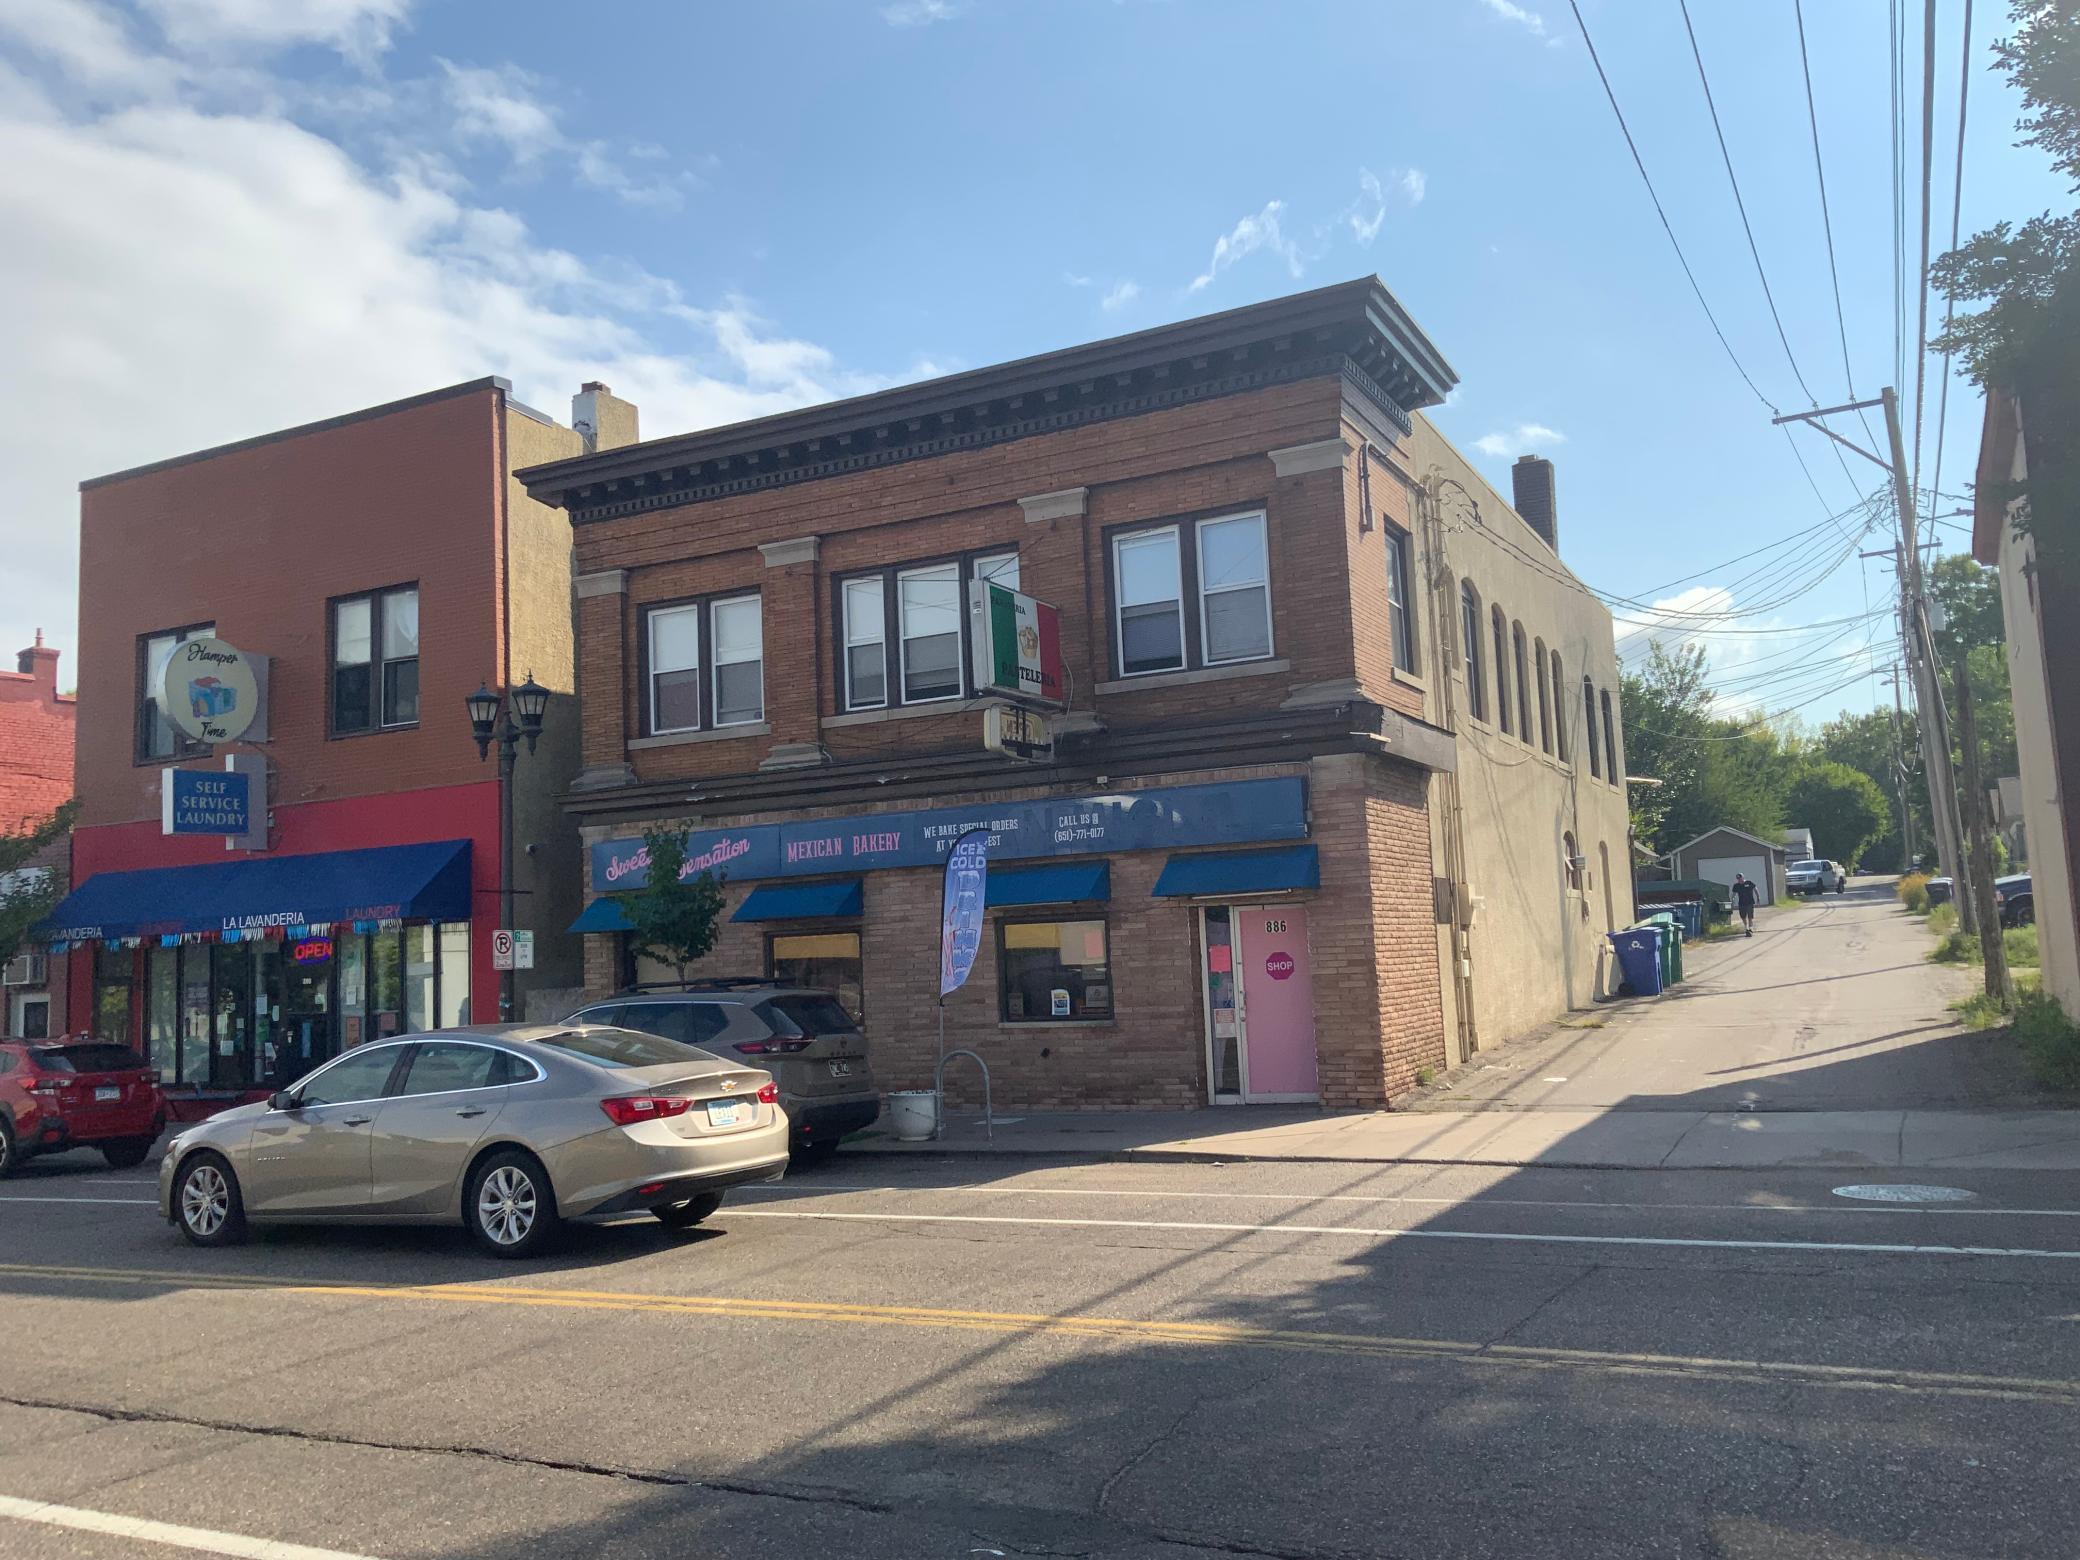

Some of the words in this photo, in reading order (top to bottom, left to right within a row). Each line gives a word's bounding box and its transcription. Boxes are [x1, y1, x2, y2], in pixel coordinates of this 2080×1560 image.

[187, 643, 239, 667] Hamper
[201, 721, 228, 738] Time
[195, 780, 227, 794] SELF
[181, 796, 241, 811] SERVICE
[176, 812, 246, 826] LAUNDRY
[1058, 815, 1078, 828] CALL
[1080, 813, 1090, 825] US
[923, 826, 936, 839] WE
[938, 824, 958, 836] BAKE
[991, 819, 1019, 831] ORDERS
[787, 838, 842, 862] MEXICAN
[853, 832, 900, 856] BAKERY
[936, 840, 946, 853] AT
[956, 843, 975, 855] ICE
[950, 856, 986, 869] COLD
[346, 904, 401, 921] LAUNDRY
[223, 916, 236, 930] LA
[239, 911, 305, 929] LAVANDERIA
[1266, 920, 1287, 932] 886
[294, 943, 333, 960] OPEN
[1267, 961, 1293, 971] SHOP
